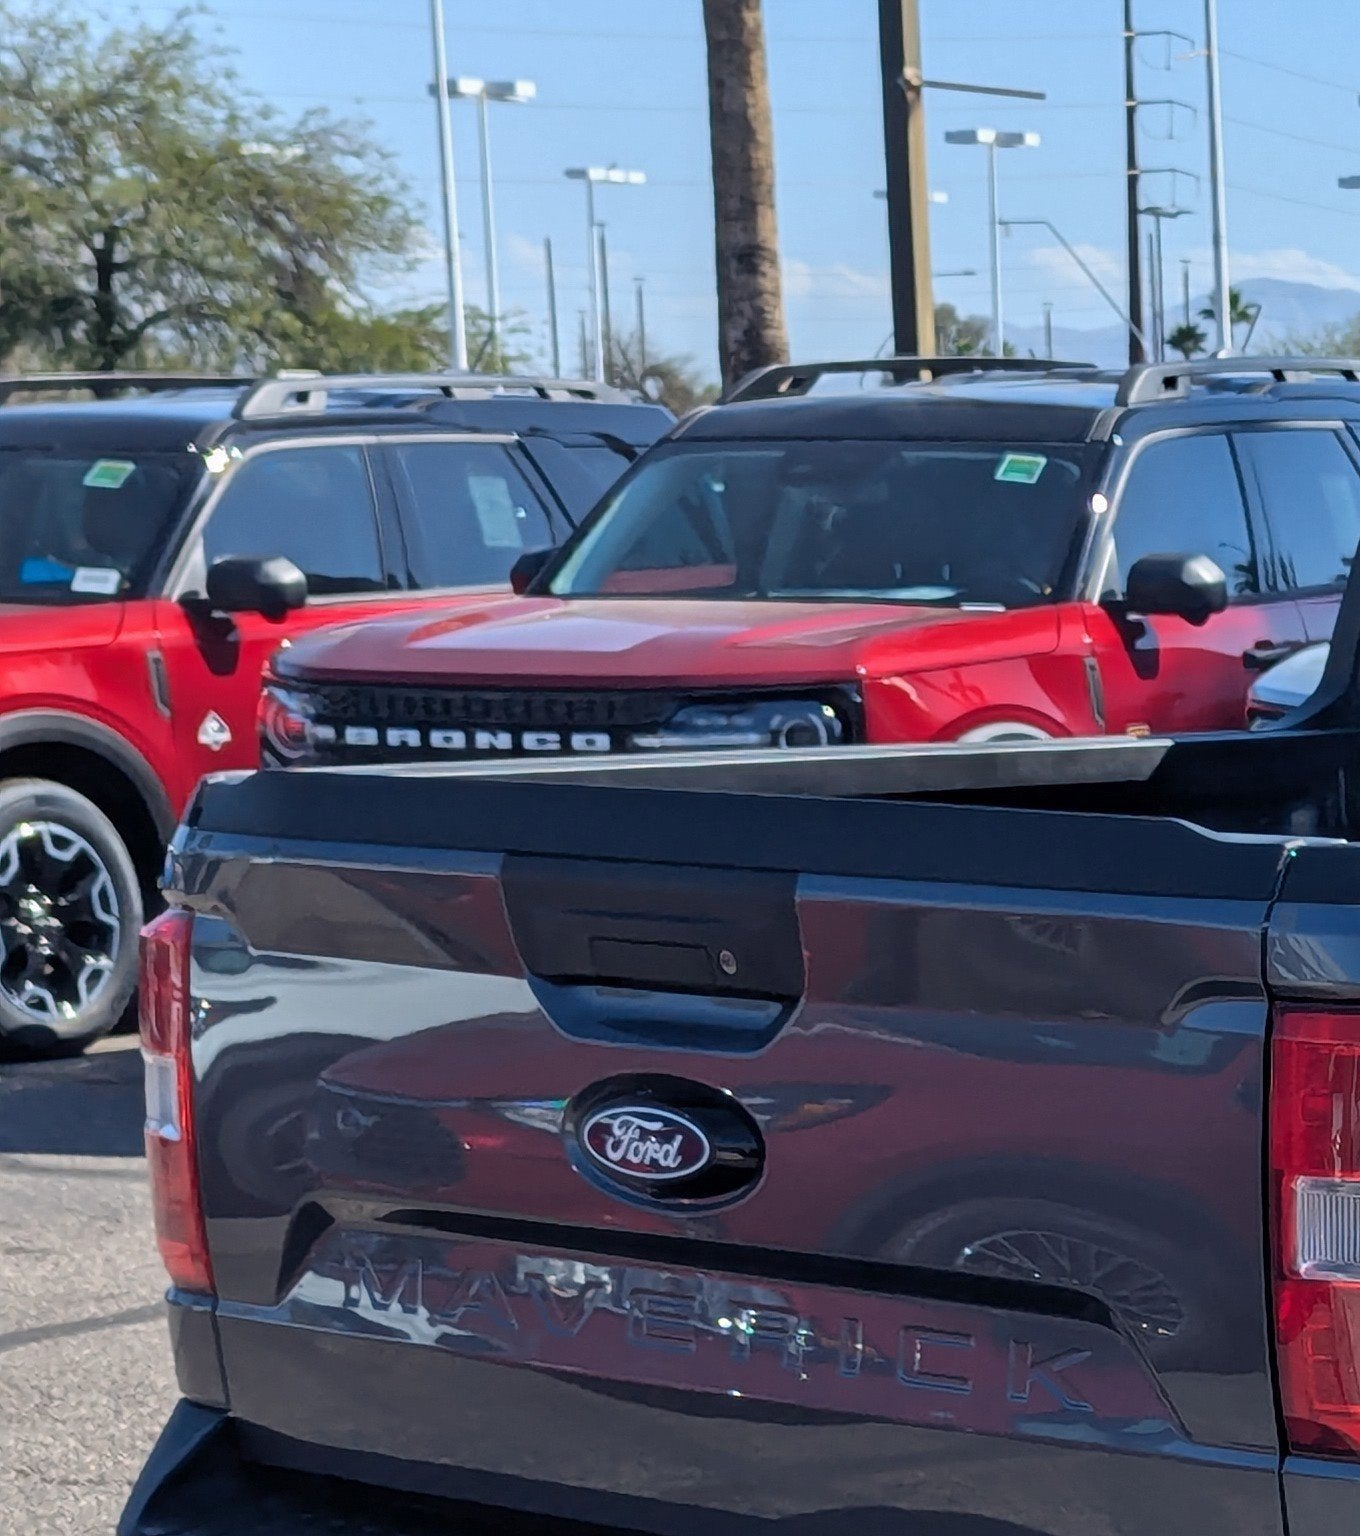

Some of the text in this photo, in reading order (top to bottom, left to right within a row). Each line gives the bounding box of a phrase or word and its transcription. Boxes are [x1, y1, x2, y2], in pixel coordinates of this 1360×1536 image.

[344, 726, 612, 751] BRONCO
[604, 1114, 683, 1168] Ford
[343, 1252, 1096, 1413] MAVERICK
